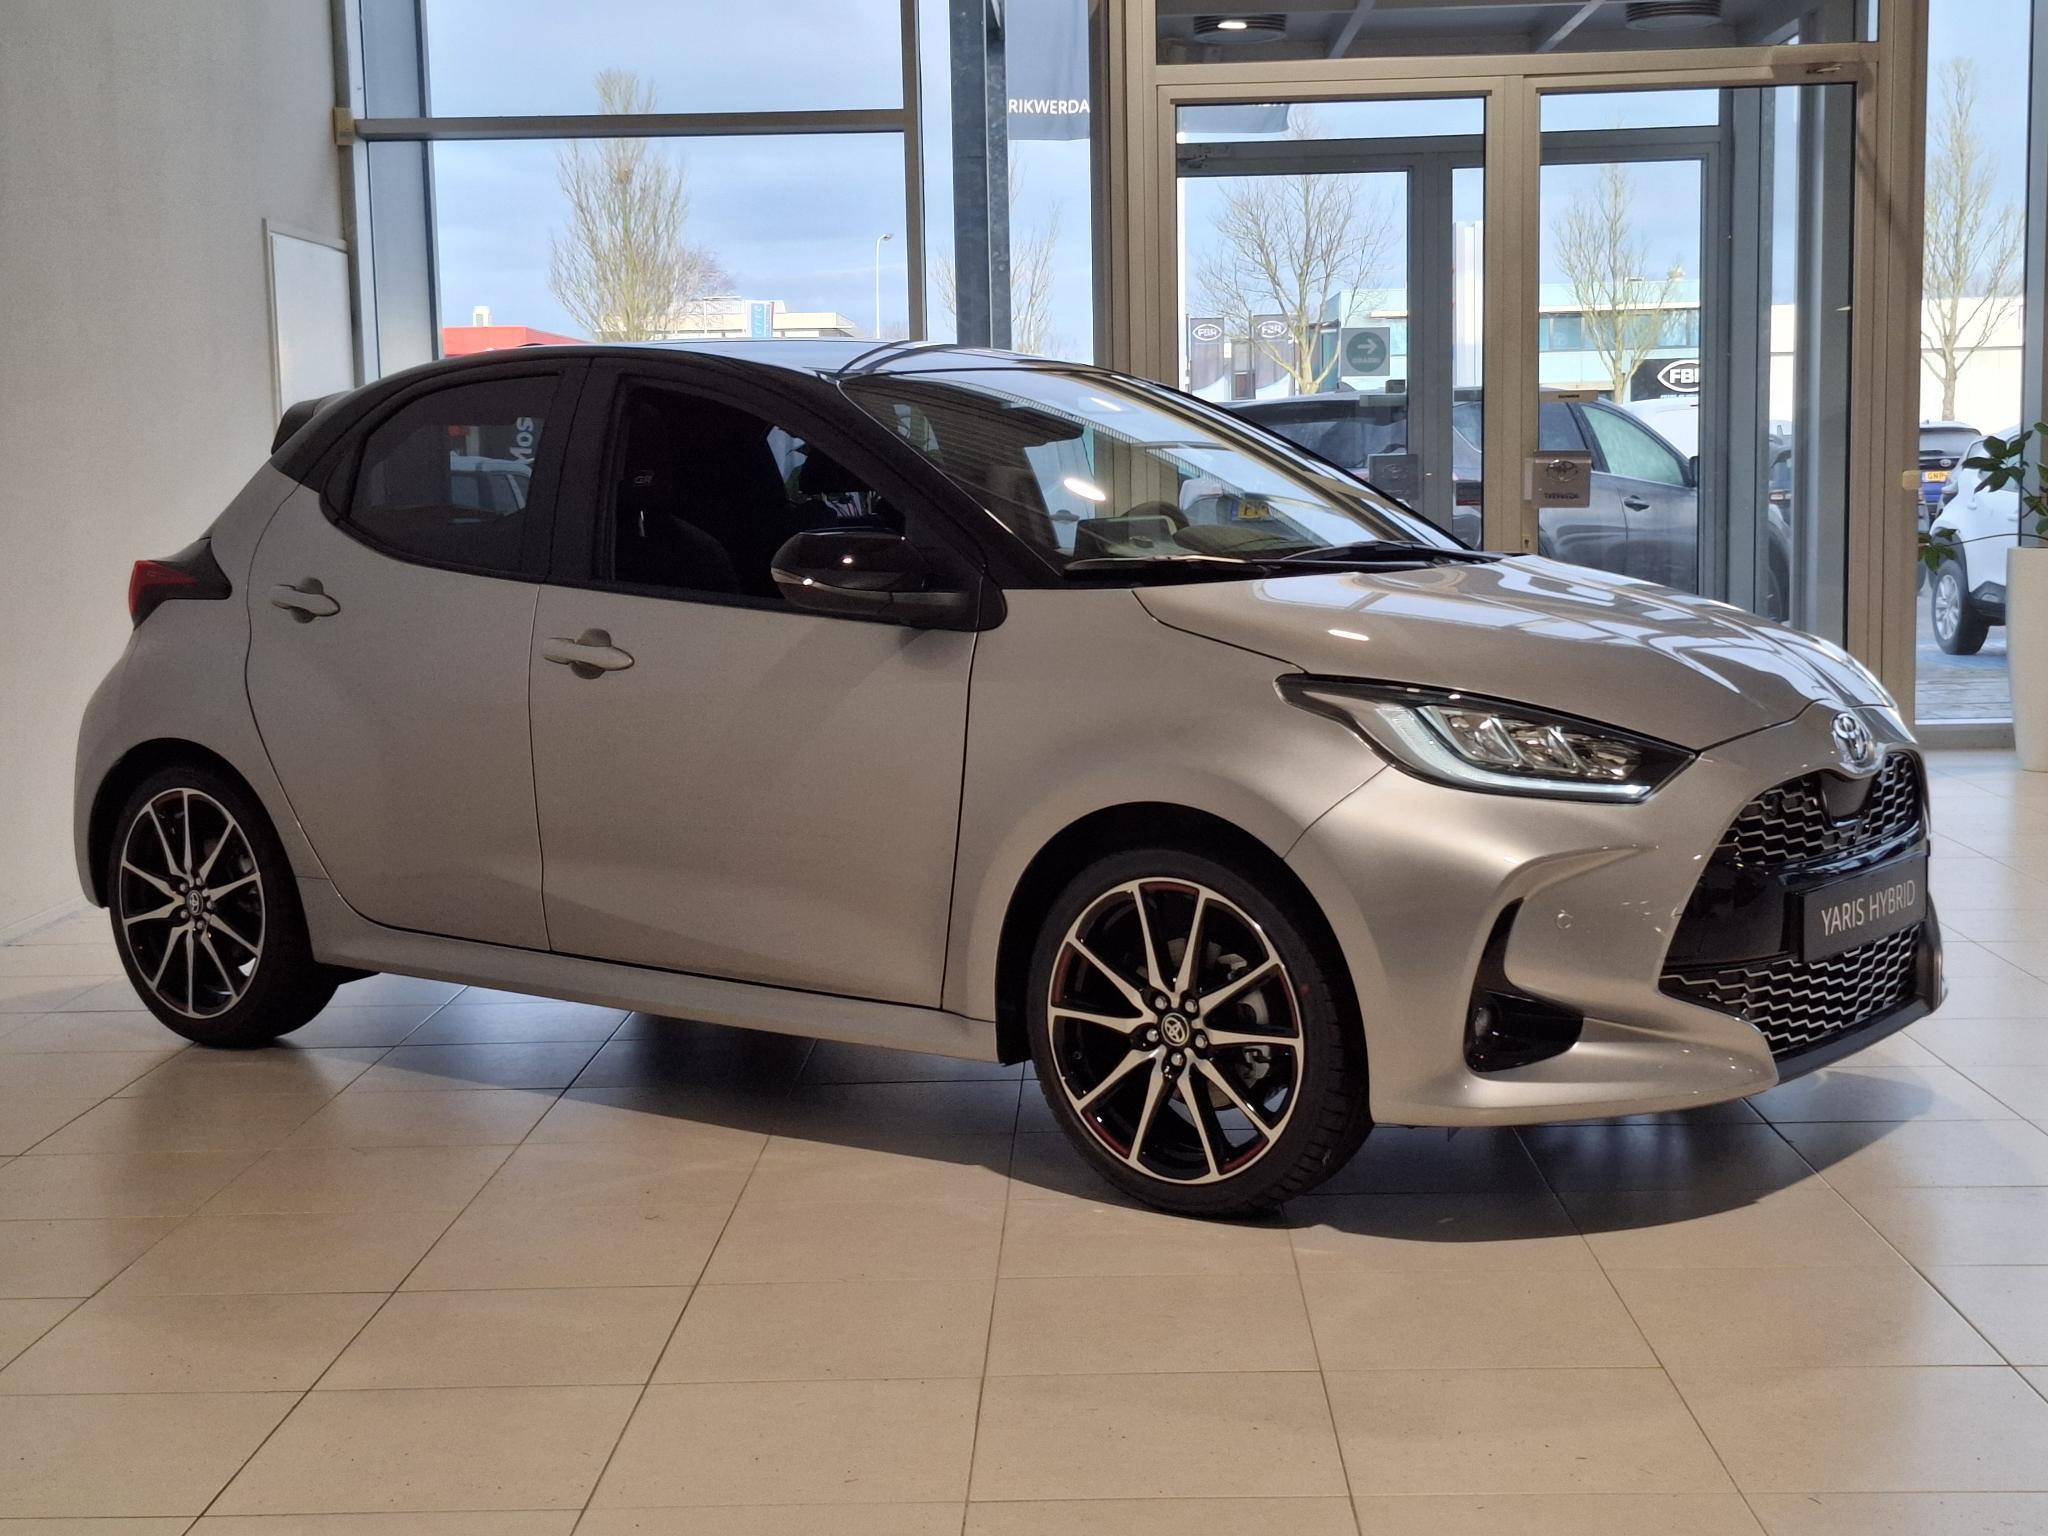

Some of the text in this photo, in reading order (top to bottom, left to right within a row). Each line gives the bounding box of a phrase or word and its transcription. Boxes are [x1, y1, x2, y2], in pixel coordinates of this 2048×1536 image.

[1008, 98, 1090, 114] RIKWERDA
[1821, 880, 1916, 937] YARIS HYBRID
